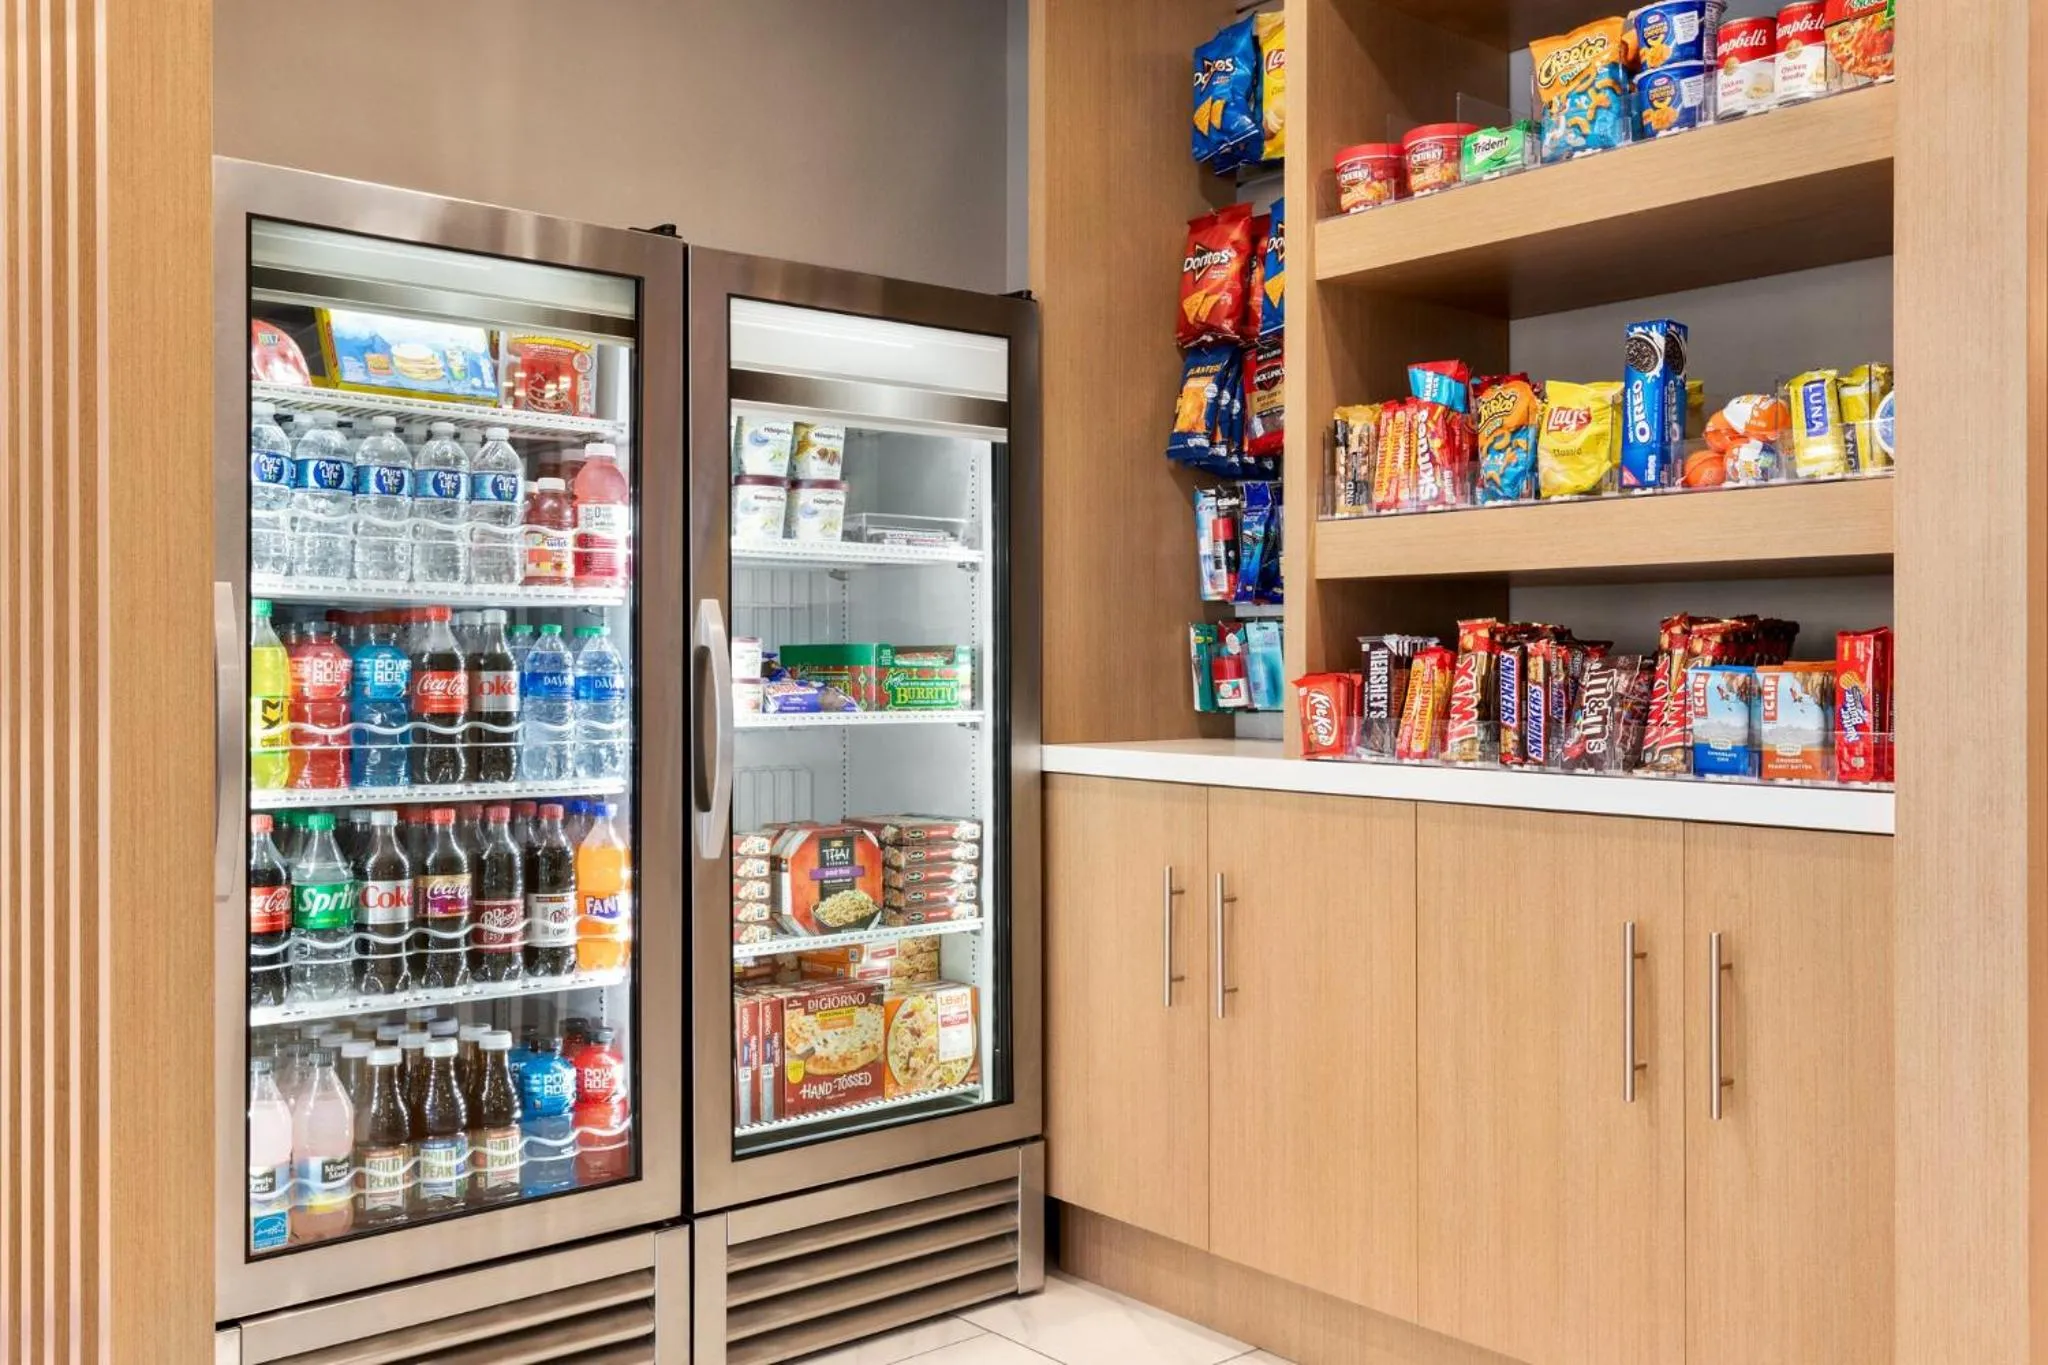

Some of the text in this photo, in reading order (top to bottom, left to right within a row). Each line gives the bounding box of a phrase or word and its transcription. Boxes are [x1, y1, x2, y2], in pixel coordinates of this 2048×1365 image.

[1267, 50, 1285, 74] La
[1473, 137, 1508, 154] Trident
[1267, 237, 1285, 254] Do
[1183, 249, 1230, 272] Doritos
[1633, 381, 1650, 443] OREO
[1807, 383, 1824, 432] LUNA
[1548, 405, 1589, 434] Lay's
[259, 453, 281, 468] Pure
[318, 459, 341, 473] Pure
[262, 465, 278, 478] Life
[321, 469, 338, 480] Life
[380, 467, 401, 480] Pure
[438, 470, 459, 483] Pure
[496, 473, 517, 486] Pure
[384, 475, 400, 487] Life
[440, 478, 457, 490] Life
[500, 481, 515, 494] Life
[478, 676, 518, 699] oke
[1370, 650, 1388, 719] HERSHEY'S
[1501, 654, 1516, 725] SNICKERS
[1694, 674, 1706, 707] CLIF
[897, 687, 957, 704] BURRITO
[1450, 656, 1477, 742] TWIX
[1764, 676, 1776, 711] CLIF
[1528, 685, 1542, 760] SNICKERS
[822, 848, 850, 862] THAI
[585, 896, 621, 914] FANT
[807, 992, 866, 1011] DIGIORNO
[799, 1072, 872, 1100] HAND-TOSSED
[422, 1165, 453, 1179] PEAK
[369, 1174, 400, 1188] PEAK
